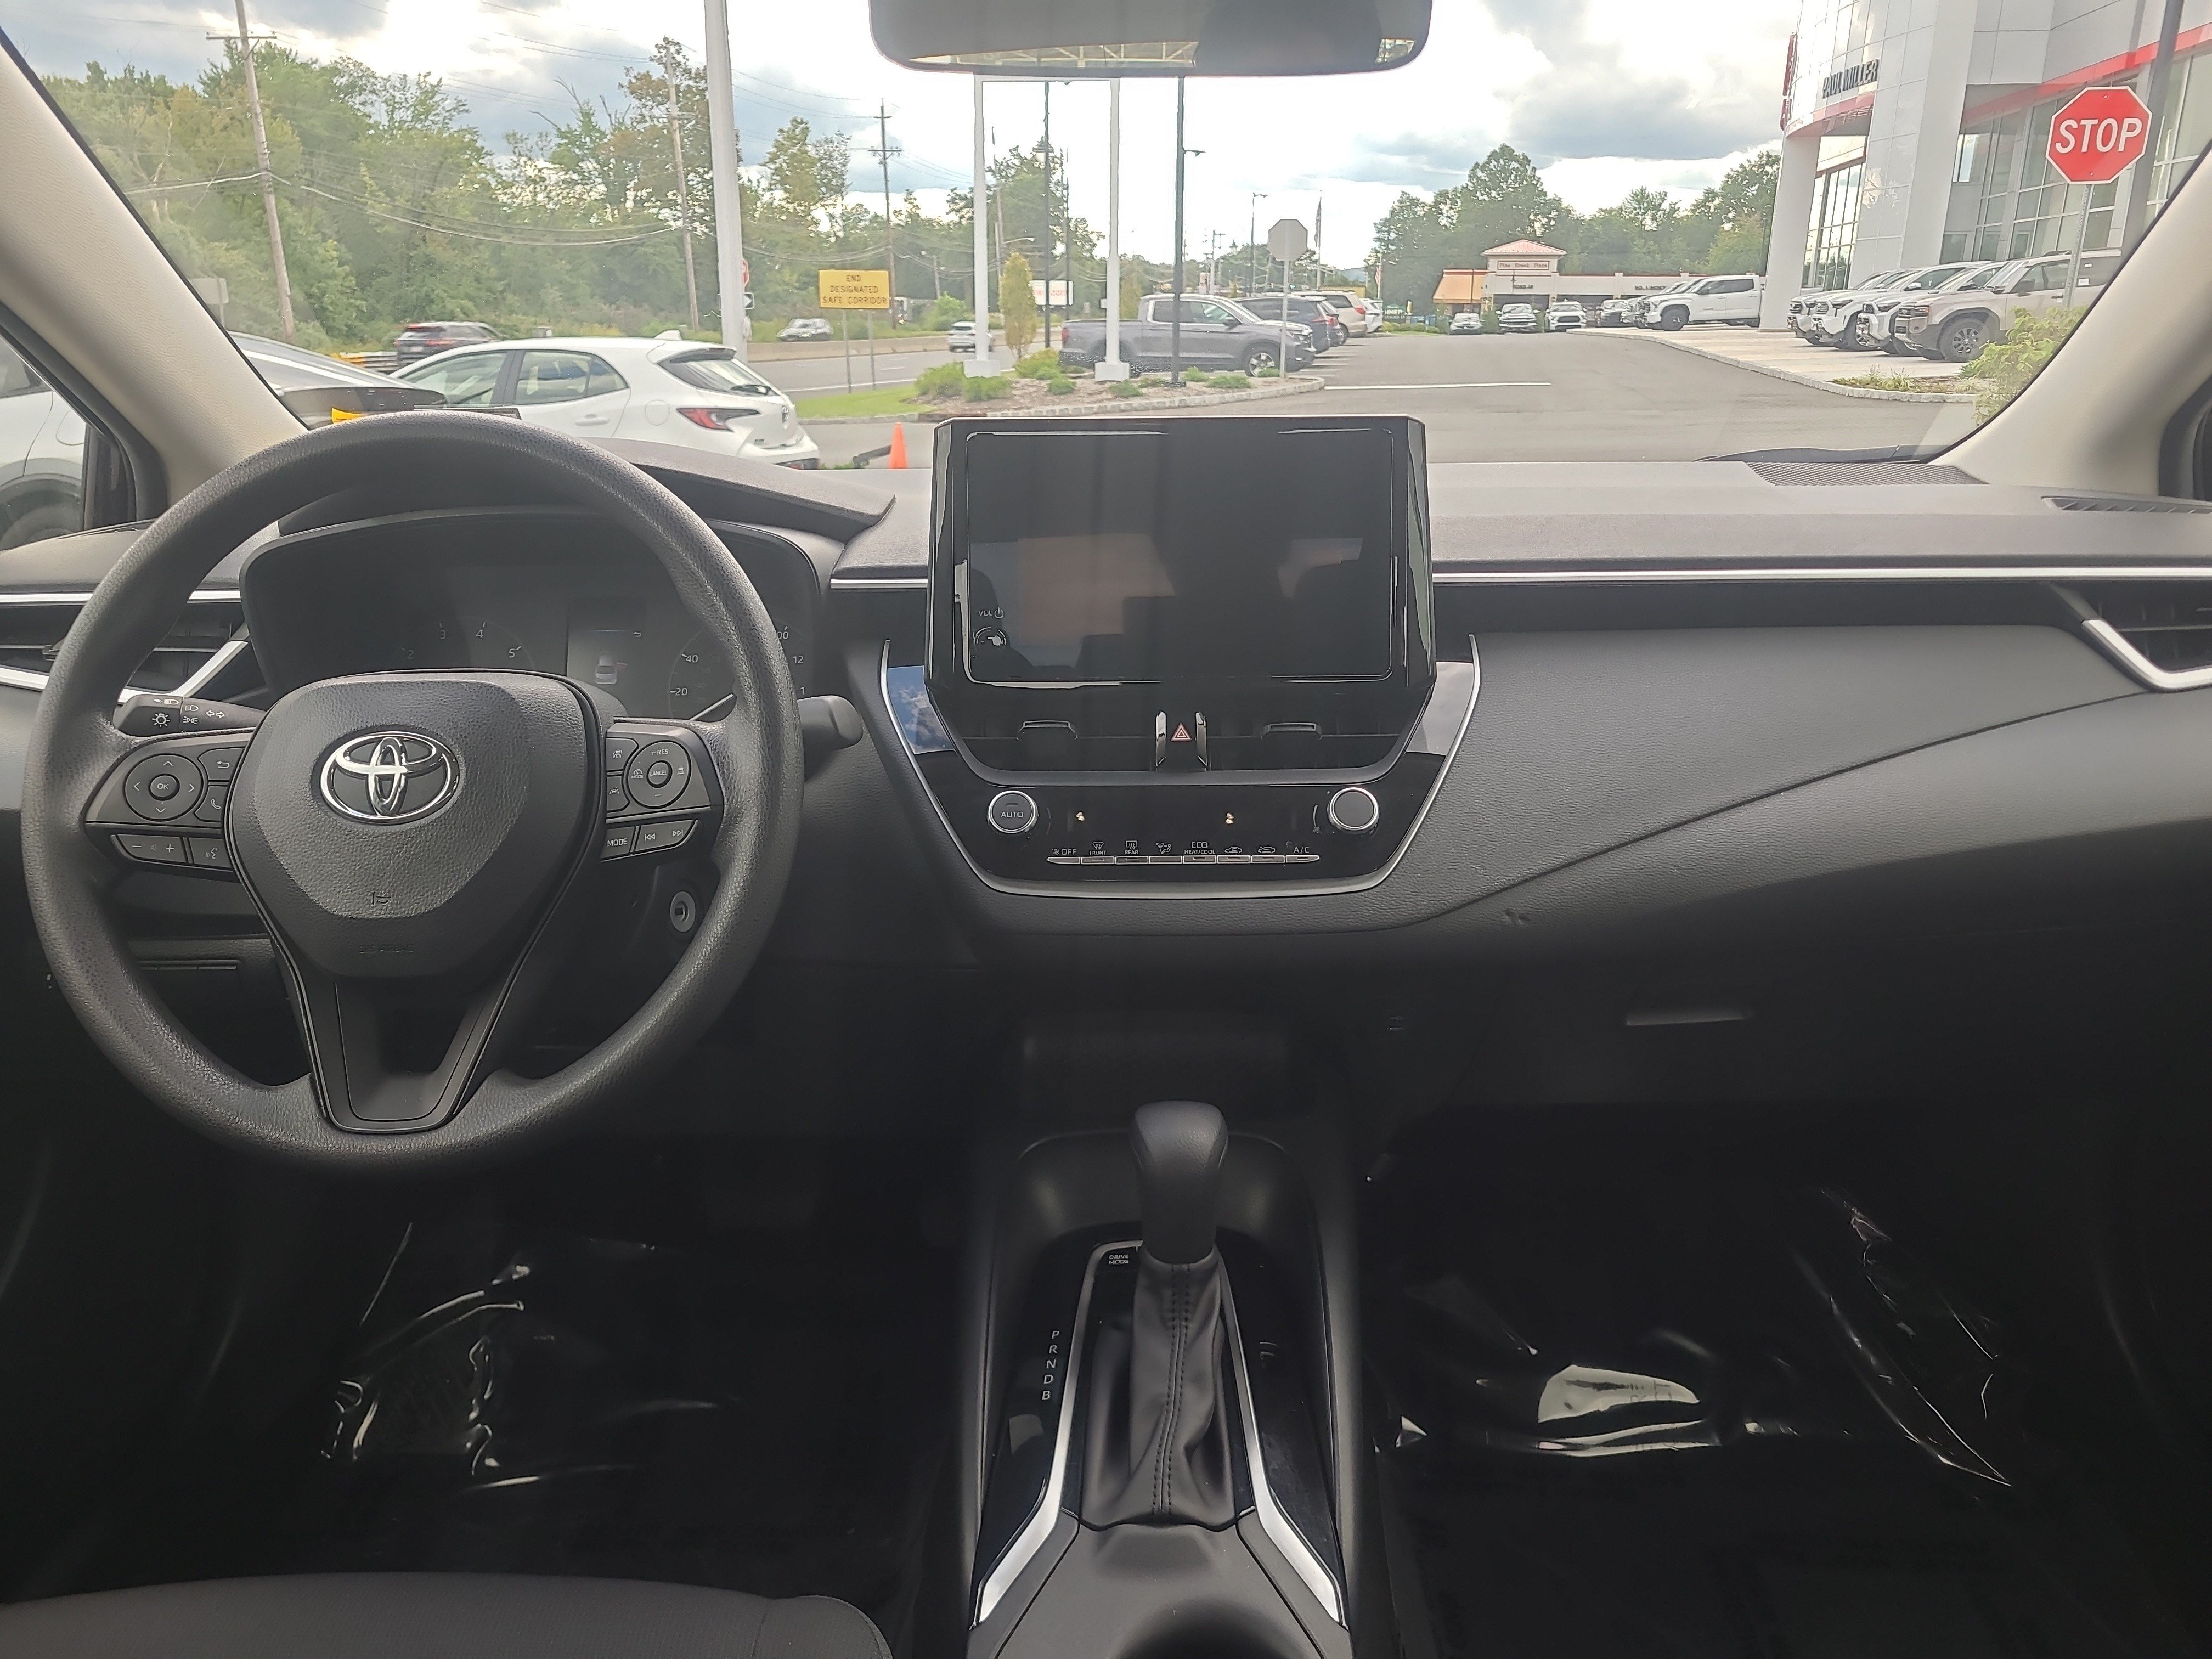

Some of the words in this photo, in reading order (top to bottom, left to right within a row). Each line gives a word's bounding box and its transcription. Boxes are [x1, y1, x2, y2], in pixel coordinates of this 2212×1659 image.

[1822, 71, 1843, 99] PAUL
[1842, 59, 1880, 91] MILLER
[2056, 117, 2142, 154] STOP
[830, 285, 878, 294] DESIGNATED
[823, 296, 843, 304] SAFE
[440, 630, 446, 639] 3
[476, 629, 483, 639] 4
[777, 631, 789, 640] 00
[407, 650, 414, 659] 2
[509, 648, 515, 658] 5
[685, 654, 698, 663] 40
[675, 687, 688, 696] 20
[607, 838, 627, 847] MODE
[1052, 1330, 1060, 1339] P
[1049, 1345, 1057, 1354] R
[1046, 1359, 1056, 1369] N
[1043, 1375, 1053, 1384] D
[1042, 1390, 1051, 1400] B
